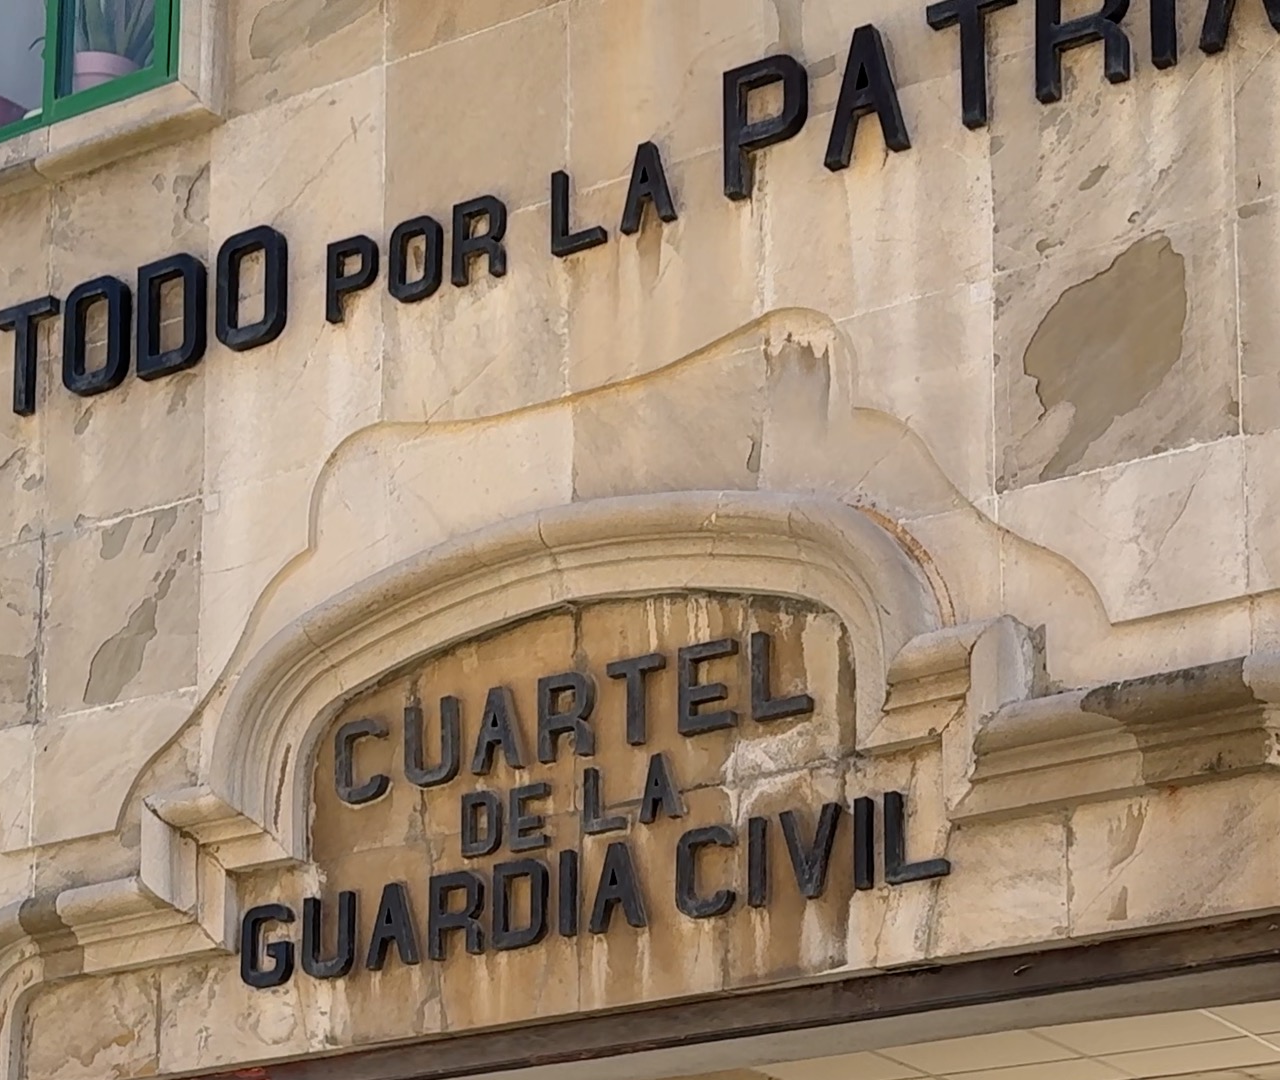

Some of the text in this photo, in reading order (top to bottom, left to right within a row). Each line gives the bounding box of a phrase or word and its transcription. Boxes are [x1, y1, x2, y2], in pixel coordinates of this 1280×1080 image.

[325, 195, 508, 325] POR
[551, 141, 679, 257] LA
[333, 631, 814, 805] CUARTEL
[461, 753, 686, 859] DE LA
[240, 790, 951, 989] GUARDIA CIVIL
